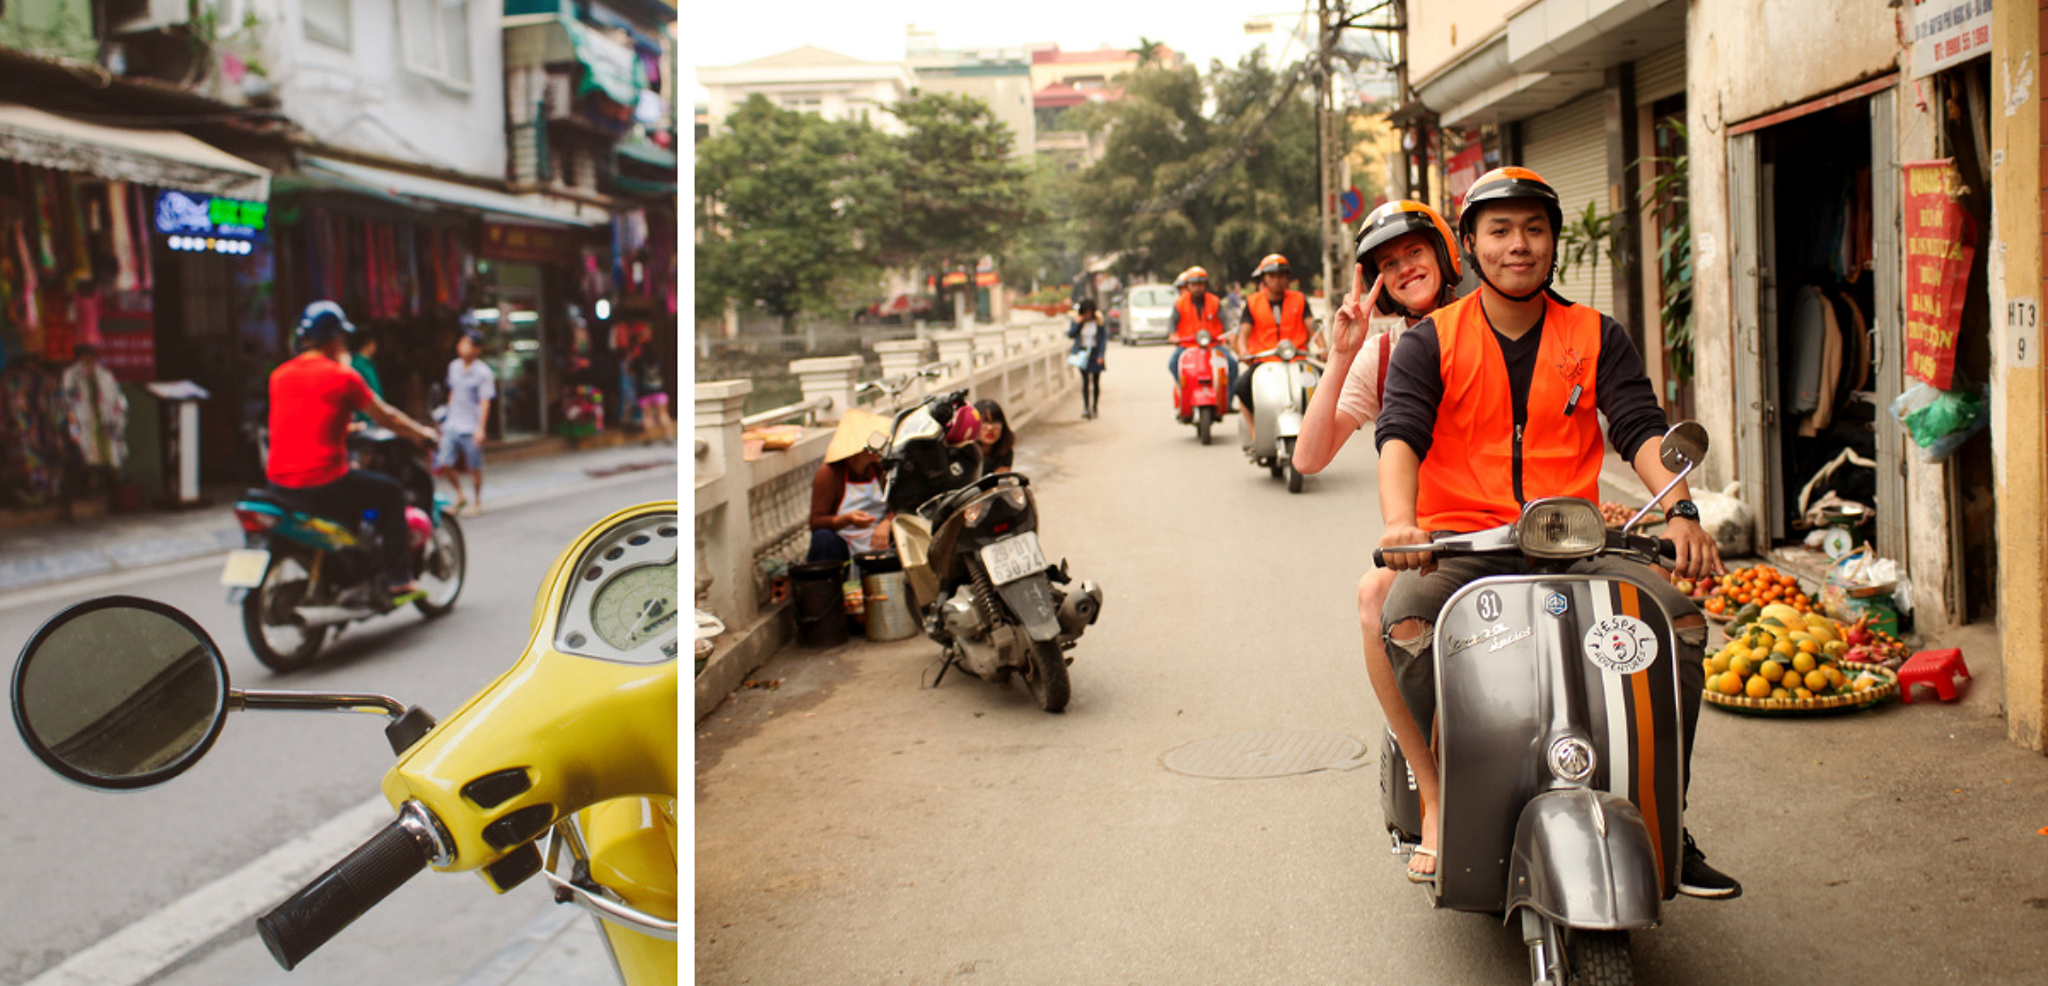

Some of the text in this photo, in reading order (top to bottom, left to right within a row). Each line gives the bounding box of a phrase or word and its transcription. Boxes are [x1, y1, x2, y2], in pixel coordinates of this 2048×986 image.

[2017, 337, 2027, 361] 9
[1481, 593, 1499, 619] 31
[1593, 617, 1637, 638] VESPA
[1594, 651, 1646, 671] ADVENTURES
